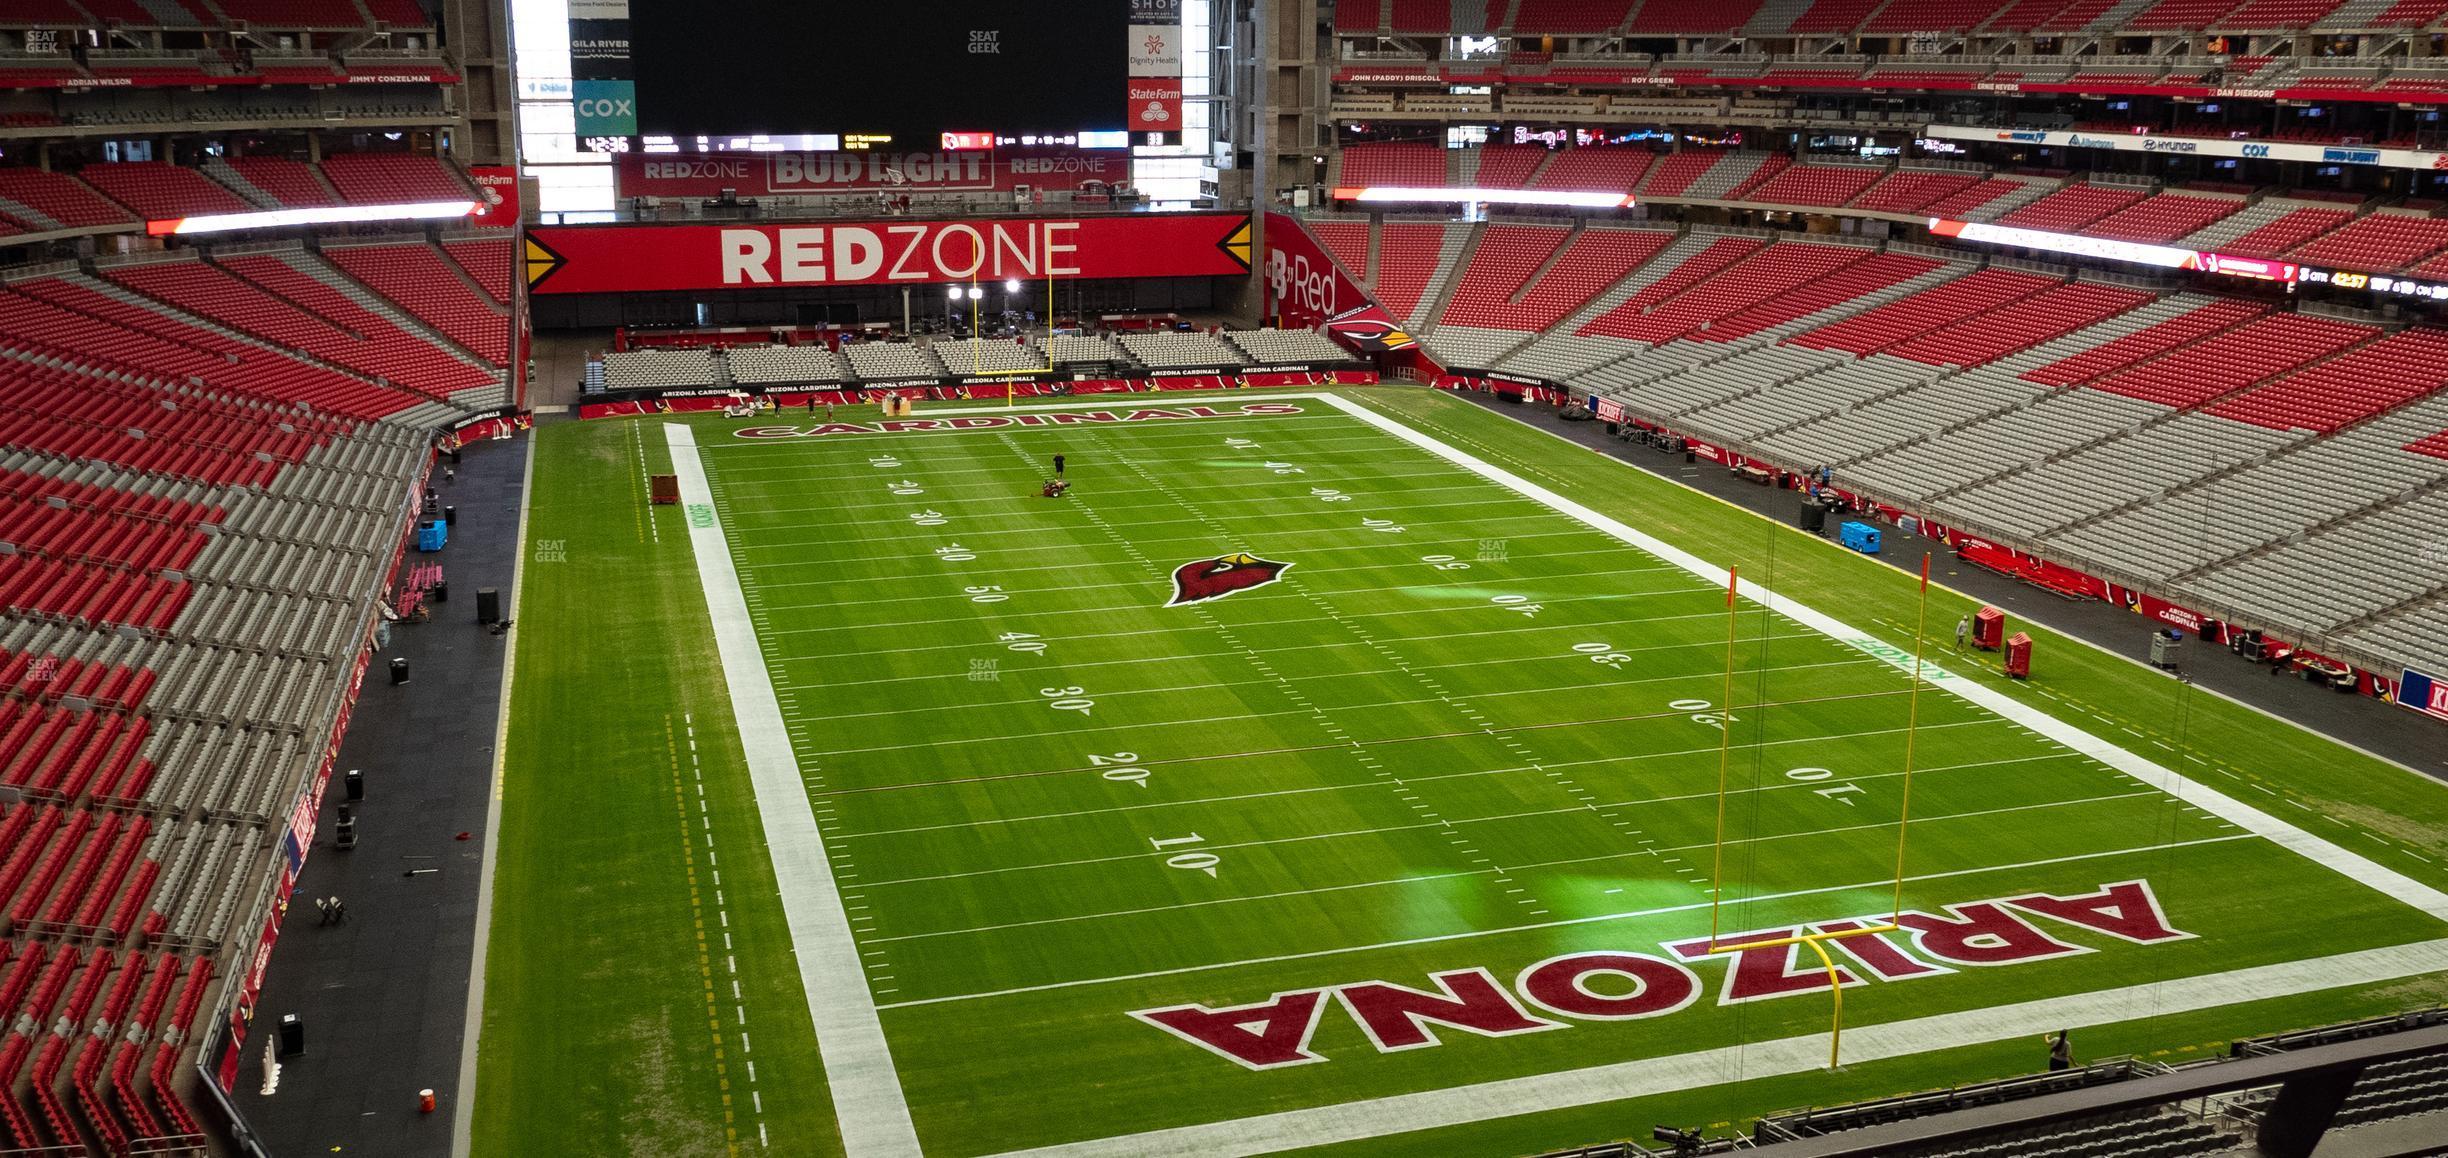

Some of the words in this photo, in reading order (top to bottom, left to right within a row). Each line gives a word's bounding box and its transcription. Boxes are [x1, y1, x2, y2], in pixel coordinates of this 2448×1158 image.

[1132, 0, 1178, 9] SHOP
[572, 40, 596, 48] GILA
[598, 40, 630, 48] RIVER
[1130, 57, 1155, 65] Dignity
[349, 75, 376, 83] JIMMY
[2217, 88, 2233, 96] DAN
[2235, 89, 2275, 98] DIERDORF
[579, 99, 632, 118] COX
[585, 136, 629, 153] 42:36
[2158, 142, 2197, 152] HYUNDAI
[2242, 144, 2269, 157] COX
[645, 162, 749, 179] REDZONE
[776, 153, 862, 183] BUD
[868, 152, 985, 182] LIGHT
[1011, 157, 1105, 174] REDZONE
[720, 222, 1081, 284] REDZONE
[2310, 272, 2329, 283] QTR
[864, 381, 897, 389] ARIZONA
[899, 379, 939, 388] CARDINALS
[1488, 372, 1511, 381] ARIZONA
[1512, 375, 1541, 386] CARDINALS
[662, 390, 696, 398] ARIZONA
[698, 388, 741, 396] CARDINALS
[800, 384, 841, 392] CARDINALS
[733, 403, 1305, 438] CARDINALS
[1262, 461, 1304, 473] 20
[888, 480, 923, 495] 20
[1311, 489, 1351, 501] 30
[909, 512, 948, 525] 30
[1362, 518, 1407, 532] 40
[936, 546, 977, 561] 40
[1421, 554, 1471, 571] 50
[964, 586, 1009, 602] 50
[1490, 595, 1544, 613] 40
[2159, 610, 2200, 631] CARDINAL
[2169, 607, 2198, 622] ARIZONA
[1000, 631, 1047, 652] 40
[1572, 642, 1632, 663] 30
[1040, 686, 1095, 710] 30
[1669, 699, 1741, 723] 20
[1088, 751, 1151, 782] 20
[1786, 766, 1867, 797] 10
[1149, 832, 1220, 869] 10
[1127, 877, 2200, 1071] ARIZONA
